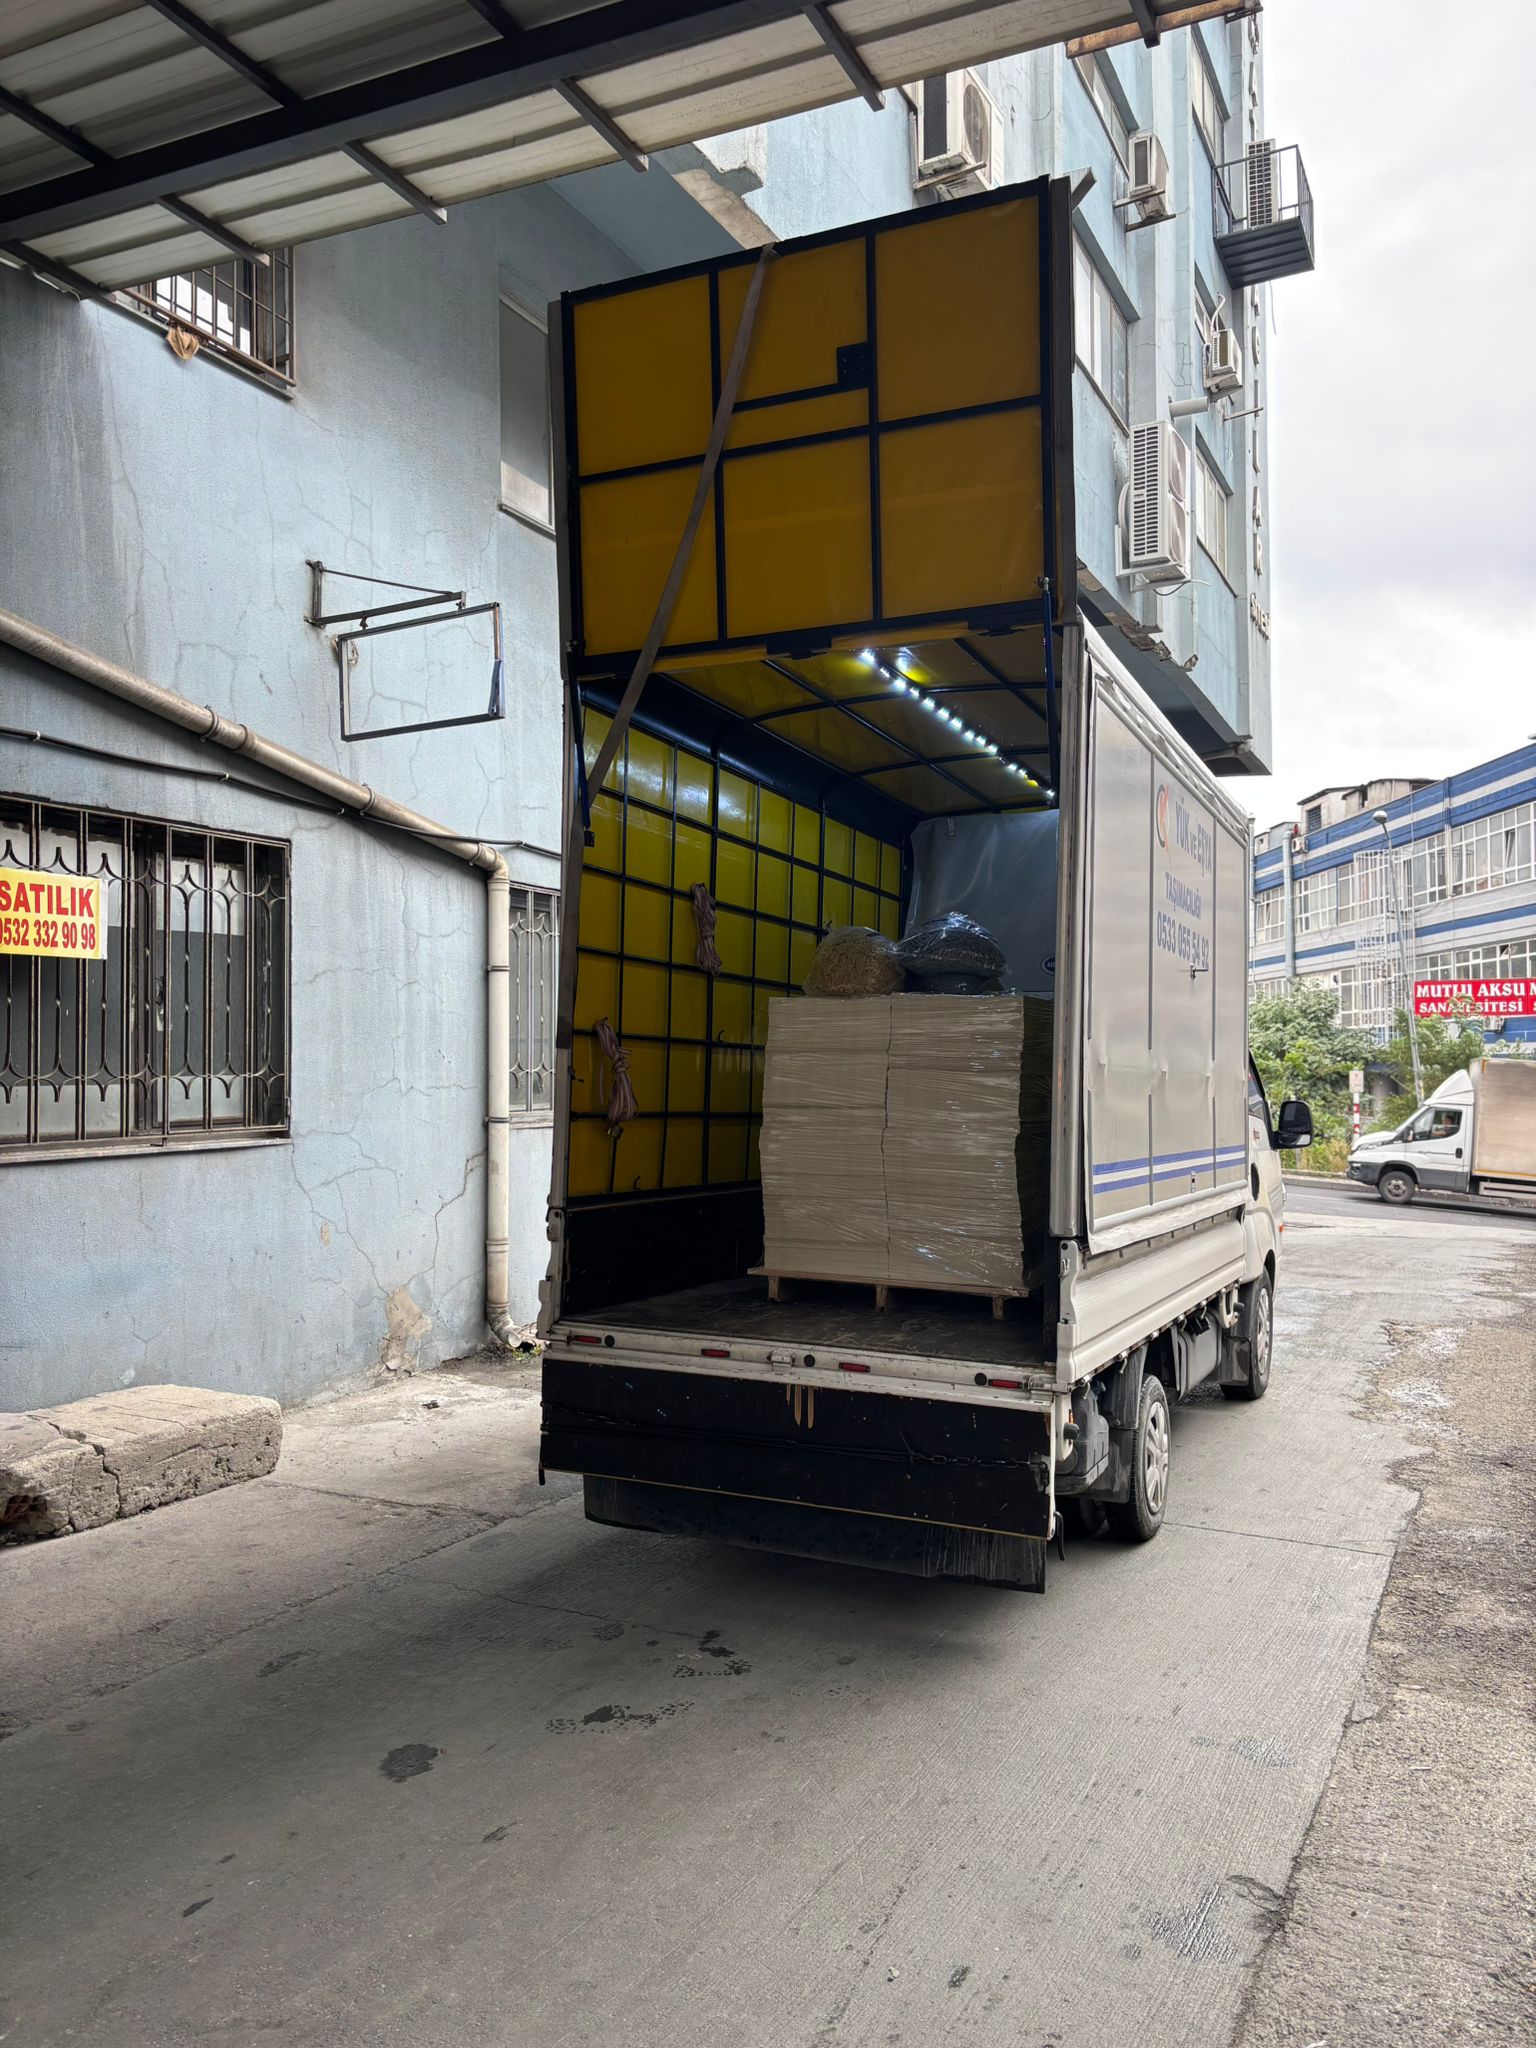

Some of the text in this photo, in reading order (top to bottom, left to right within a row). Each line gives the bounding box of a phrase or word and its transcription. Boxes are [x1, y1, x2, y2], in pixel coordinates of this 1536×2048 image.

[1175, 797, 1212, 877] YÜK VE EŞYA
[0, 880, 95, 918] SATILIK
[33, 919, 59, 948] 332
[62, 921, 78, 949] 90
[81, 922, 96, 950] 98
[1156, 911, 1177, 954] 0533
[1178, 923, 1191, 962] 055
[1201, 936, 1210, 969] 92
[1416, 984, 1472, 998] MUTLU
[1477, 982, 1526, 997] AKSU
[1476, 998, 1523, 1013] SİTESİ
